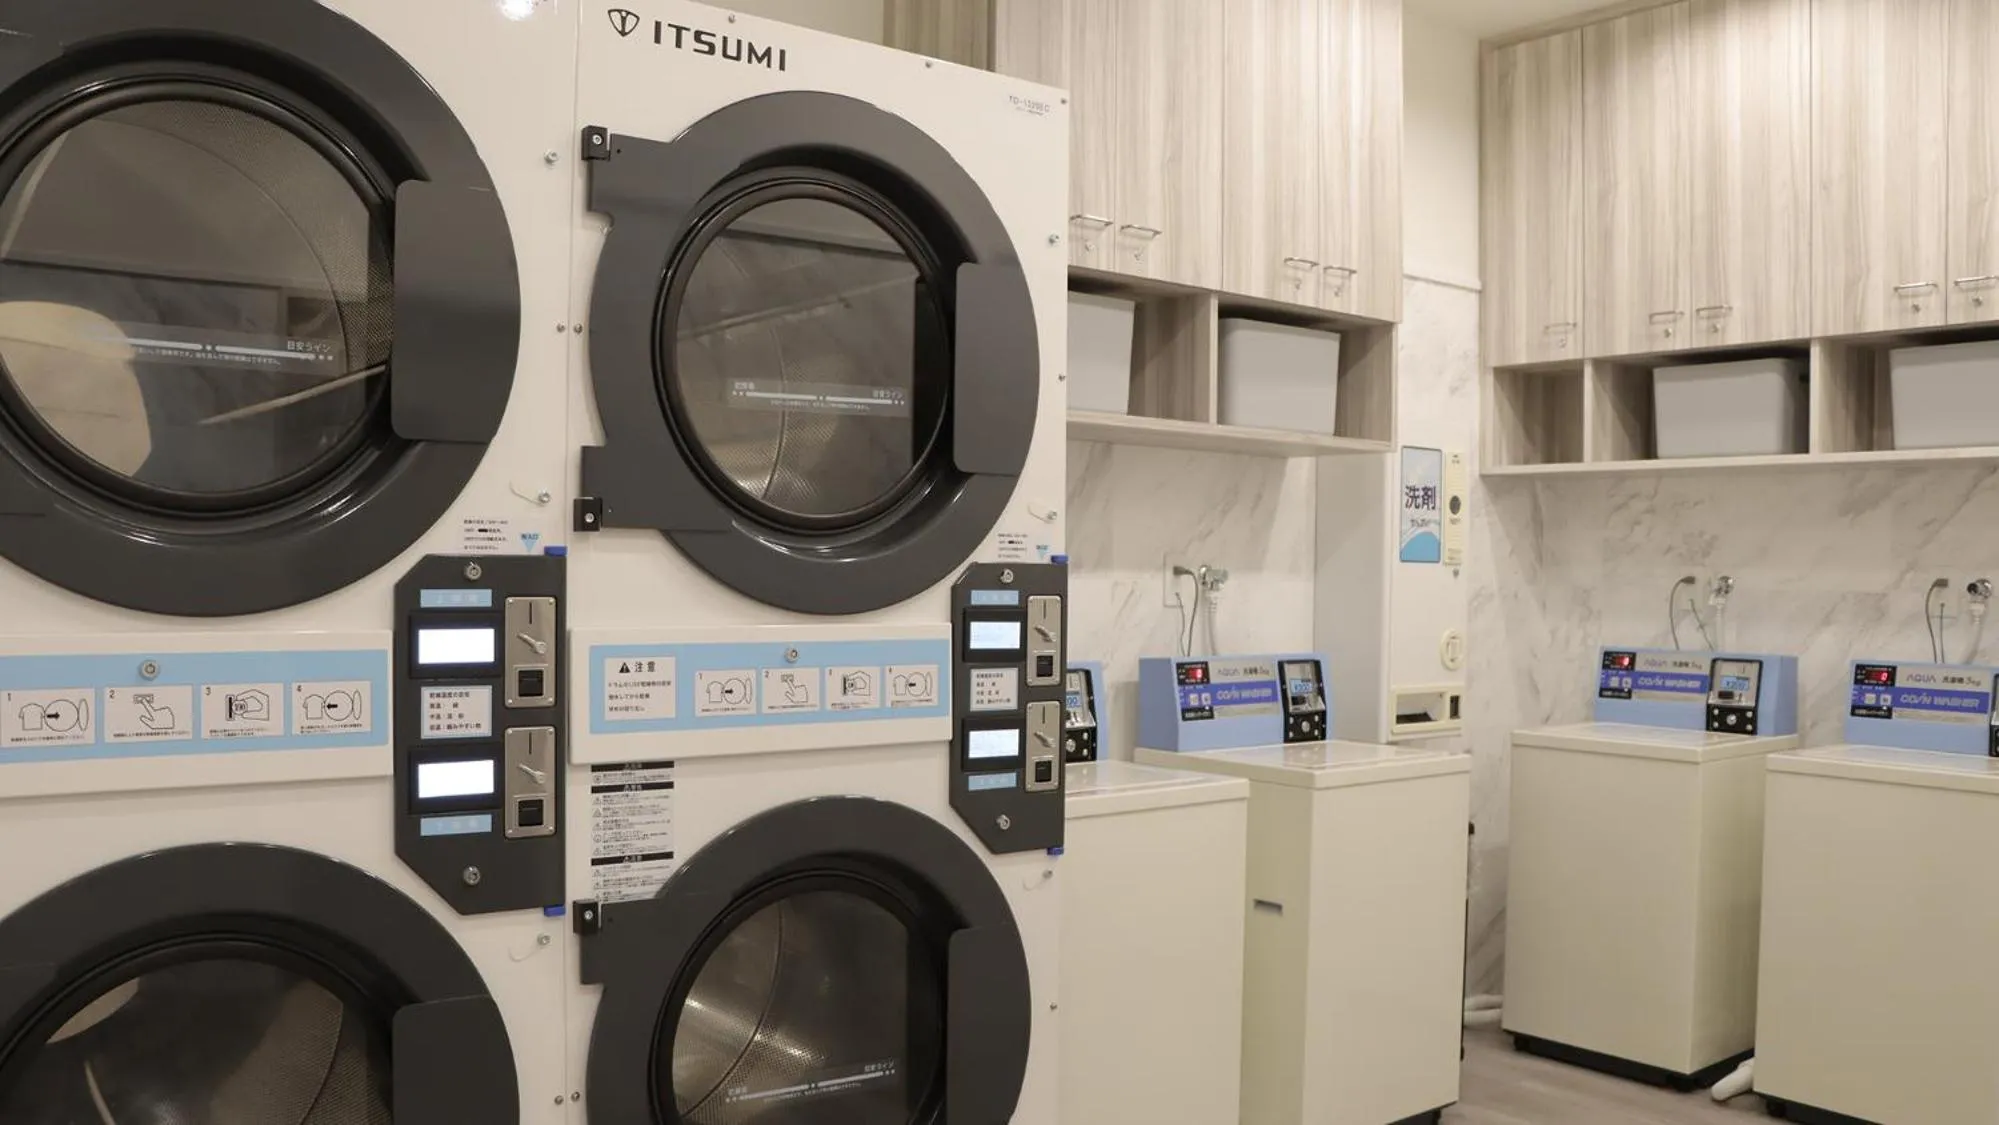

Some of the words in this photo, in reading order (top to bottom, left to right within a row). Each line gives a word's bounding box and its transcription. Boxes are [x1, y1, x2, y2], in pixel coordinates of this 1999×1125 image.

[653, 20, 786, 72] ITSUMI
[1405, 485, 1436, 510] 洗剤
[634, 661, 656, 673] 注意
[1907, 673, 1937, 683] AQUA
[109, 690, 115, 699] 2
[1934, 696, 1980, 709] WASHER
